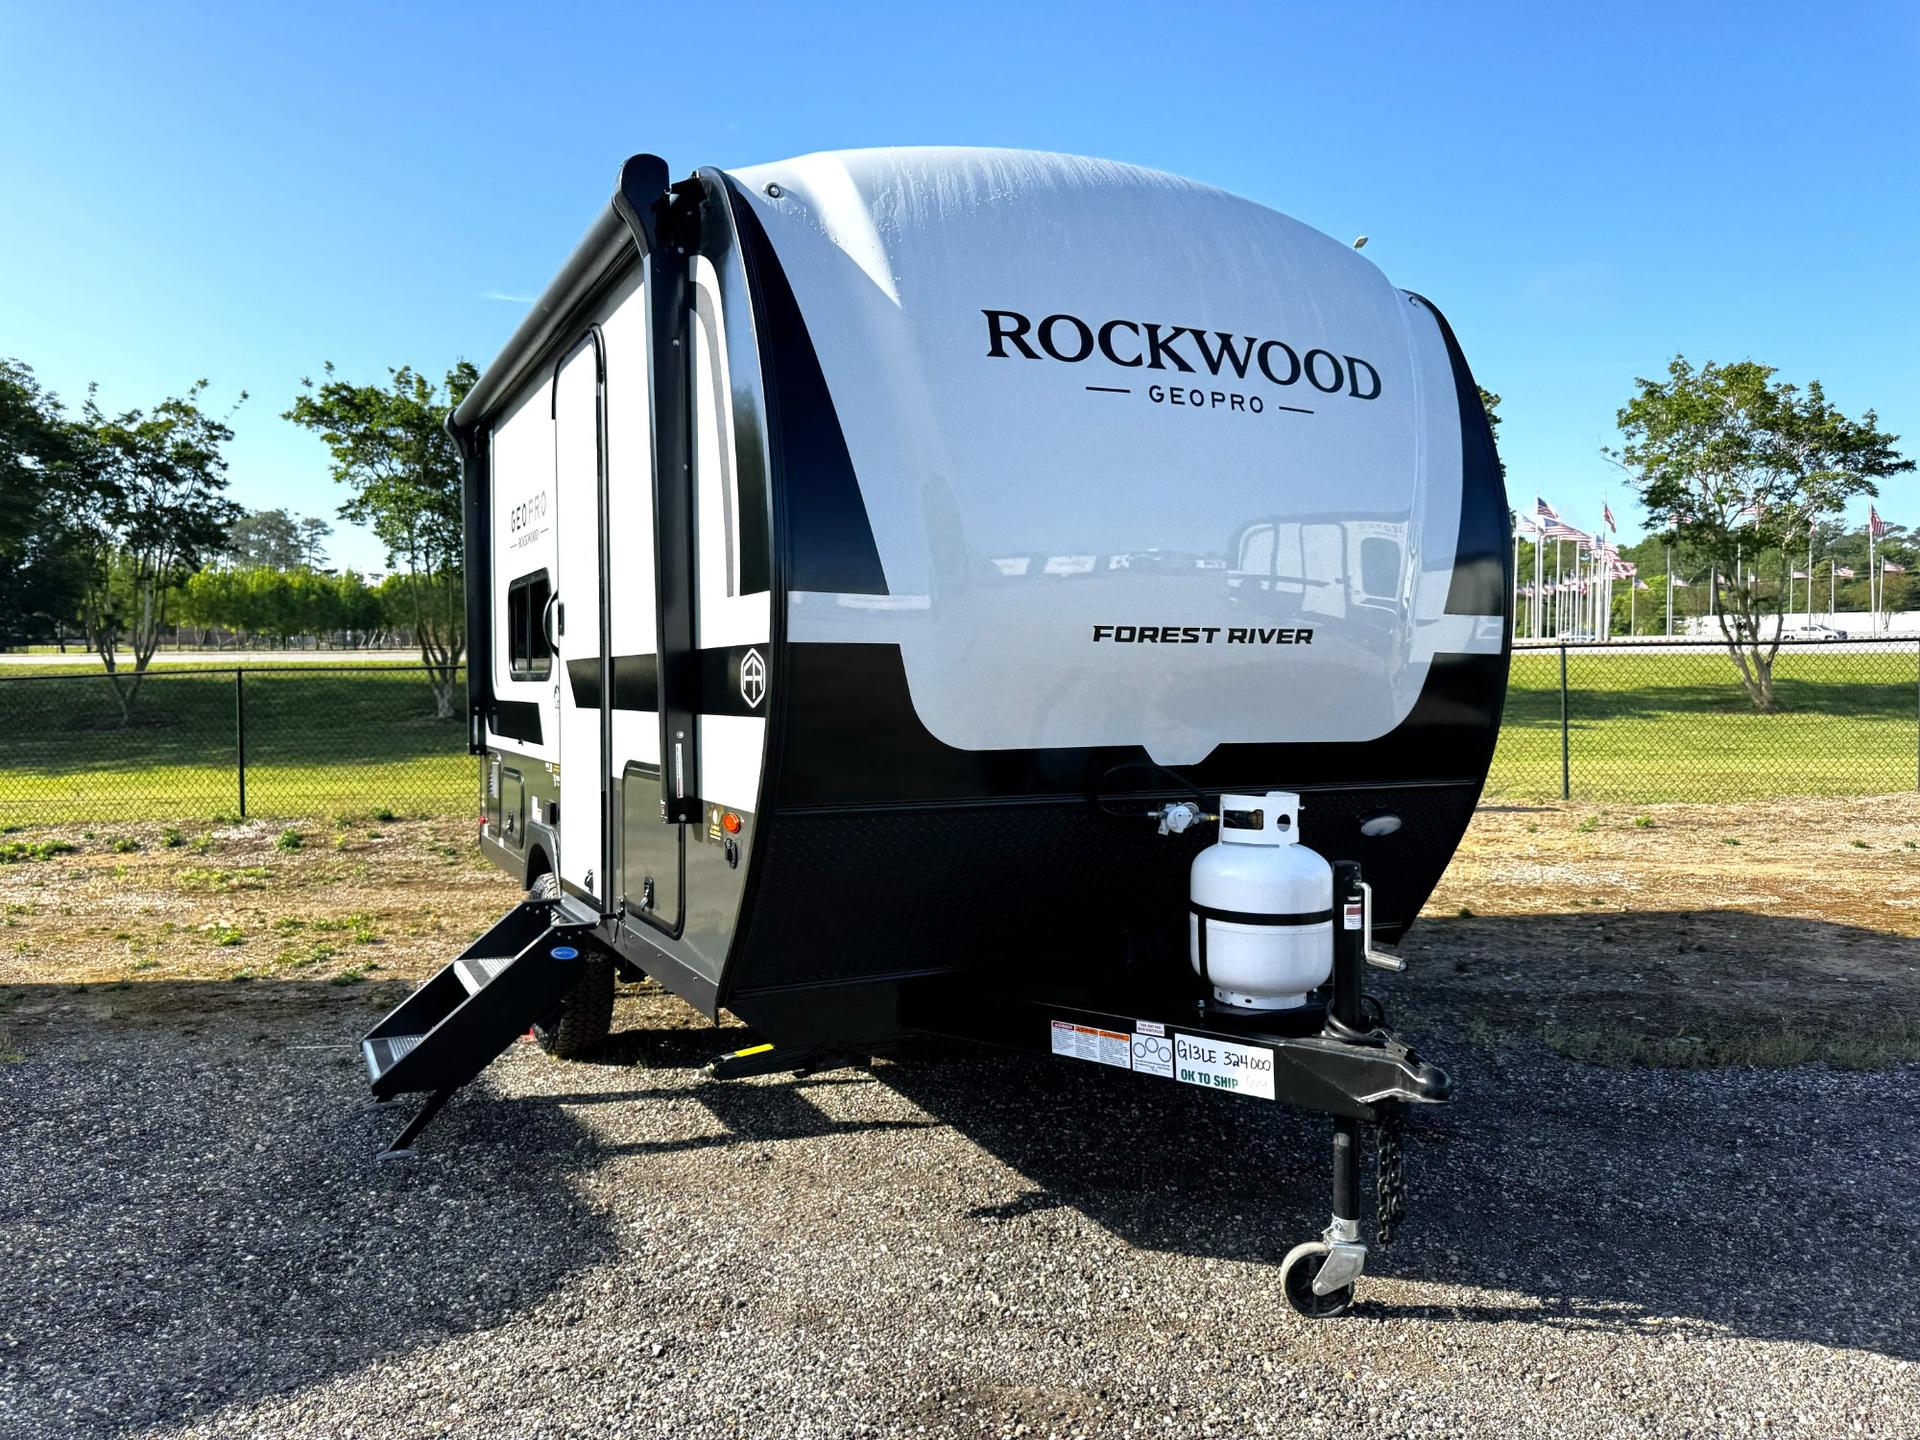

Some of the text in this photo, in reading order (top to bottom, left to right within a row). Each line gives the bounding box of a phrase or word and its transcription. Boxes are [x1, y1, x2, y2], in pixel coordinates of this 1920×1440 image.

[981, 309, 1383, 401] ROCKWOOD
[1148, 384, 1265, 415] GEOPRO
[510, 490, 547, 534] GEOPRO
[1092, 625, 1314, 645] FOREST RIVER
[1180, 1068, 1196, 1082] OK
[1197, 1071, 1212, 1085] TO
[1213, 1075, 1239, 1090] SHIP
